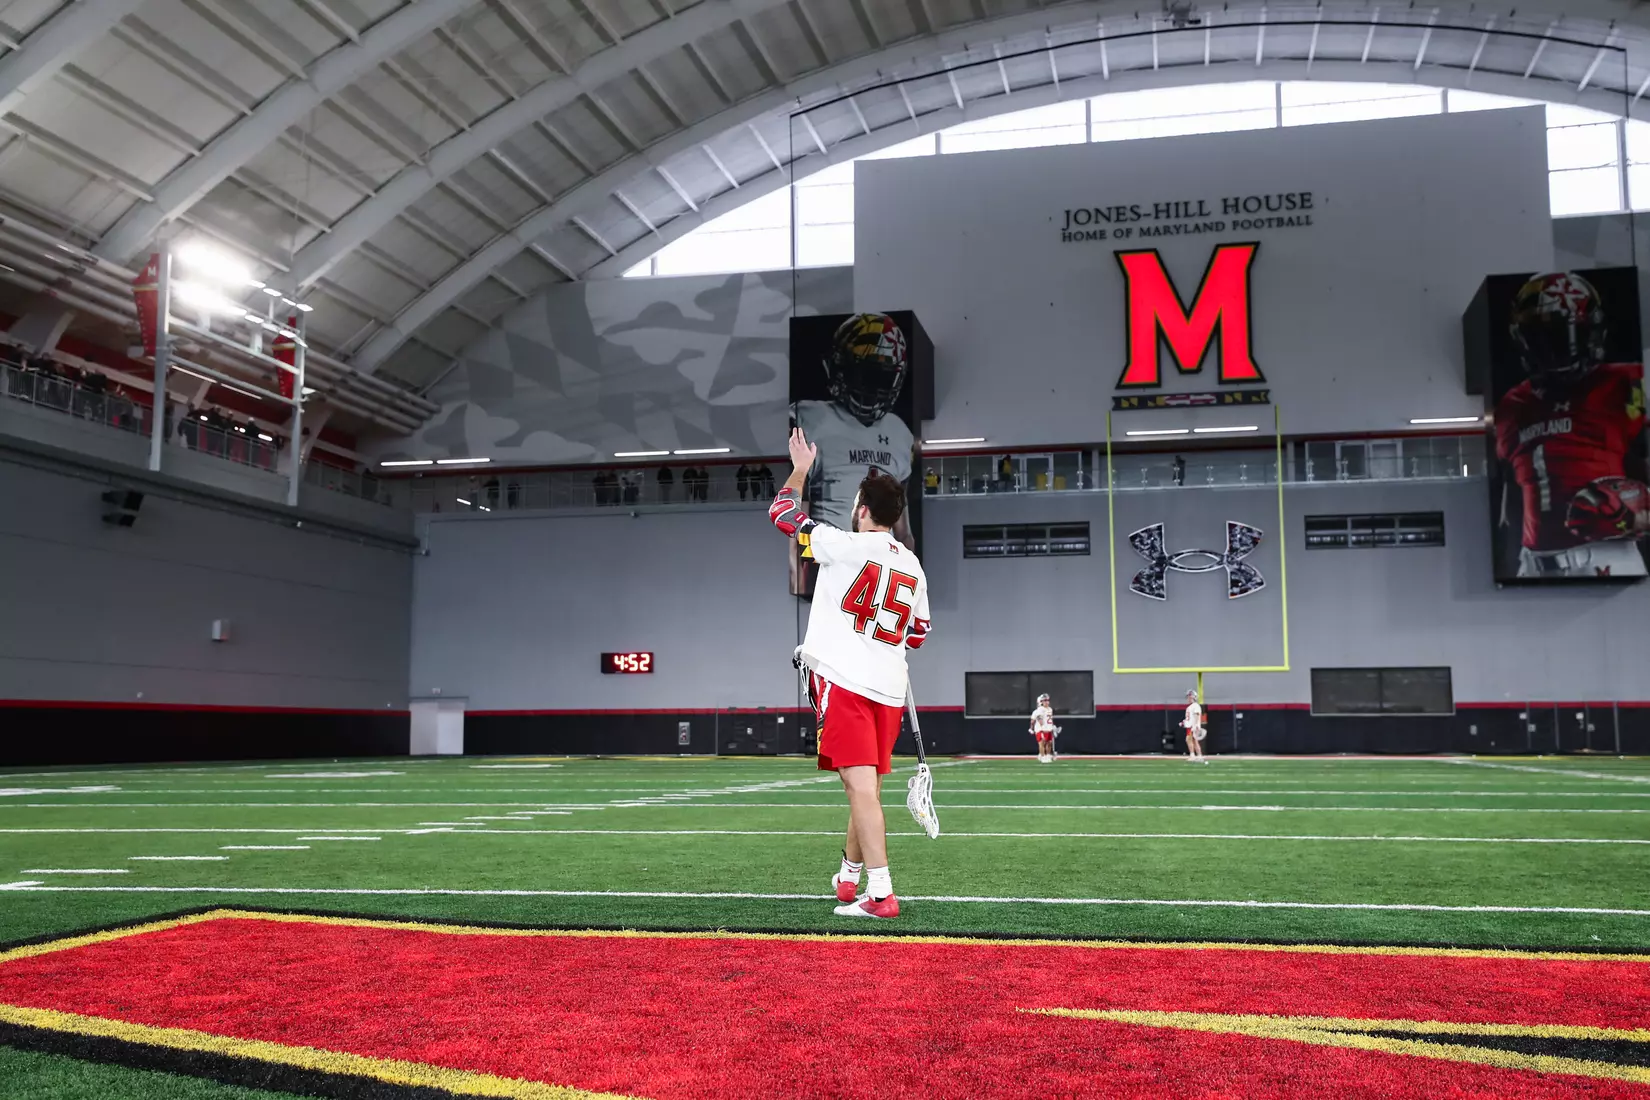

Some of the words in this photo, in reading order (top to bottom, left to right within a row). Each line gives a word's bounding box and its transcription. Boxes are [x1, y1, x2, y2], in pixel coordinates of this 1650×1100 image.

[1061, 200, 1212, 232] JONES-HILL
[1221, 191, 1314, 215] HOUSE
[1062, 229, 1107, 242] HOME
[1113, 227, 1133, 239] OF
[1139, 221, 1226, 238] MARYLAND
[1232, 215, 1314, 231] FOOTBALL
[1113, 241, 1267, 390] M
[1519, 417, 1572, 444] MARYLAND
[849, 449, 891, 466] MARYLAND
[841, 560, 918, 646] 45
[614, 653, 650, 671] 4:52
